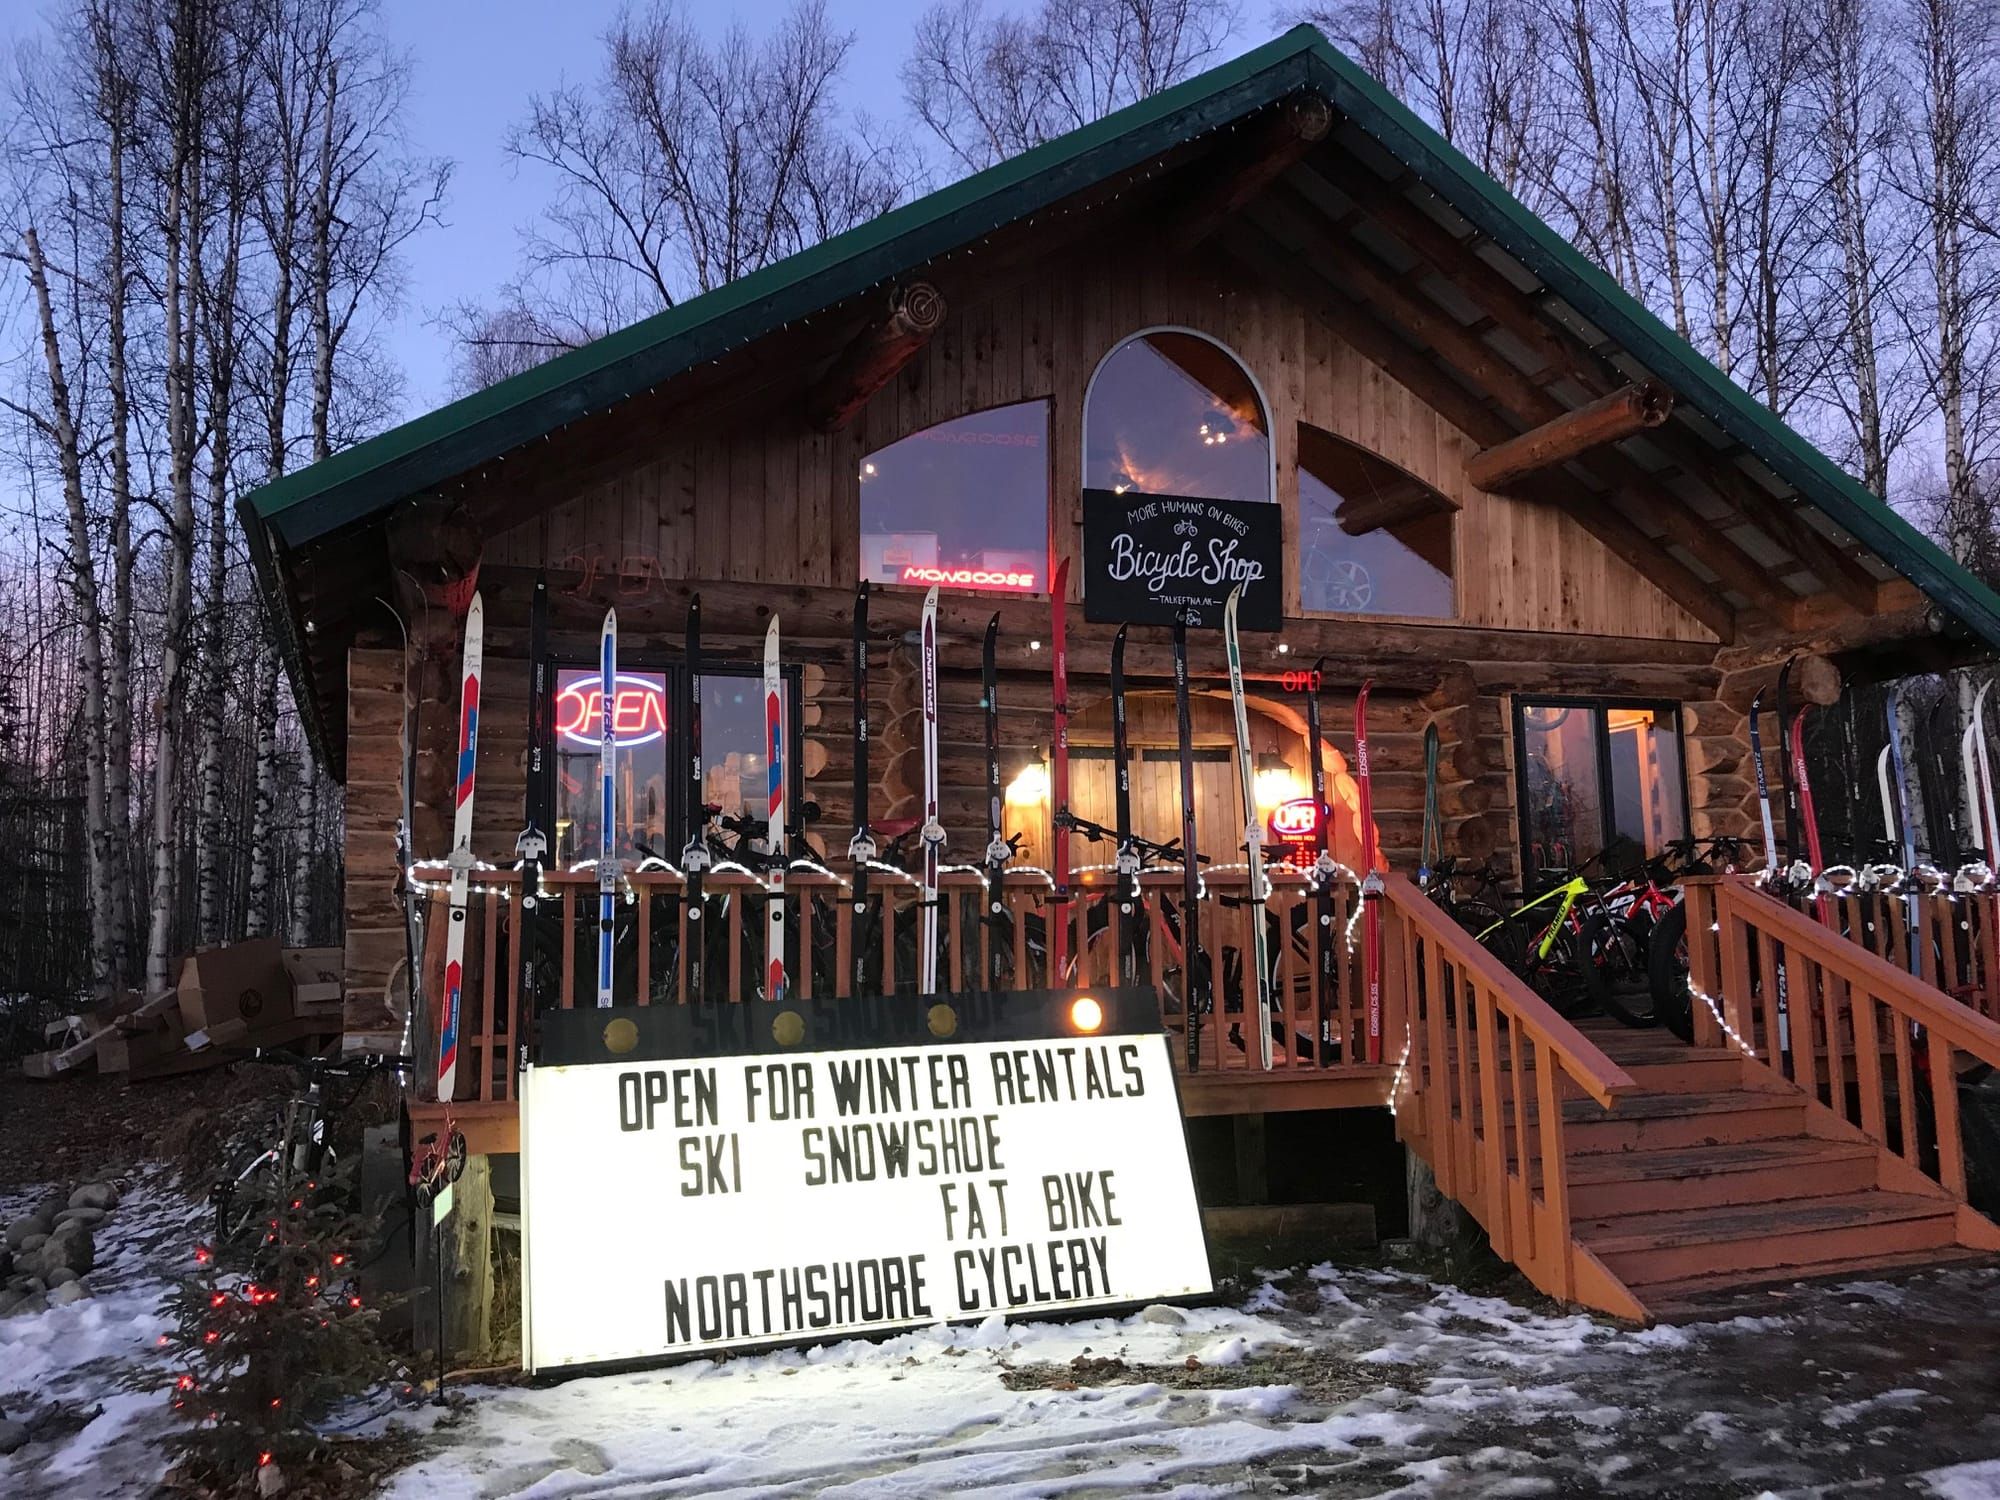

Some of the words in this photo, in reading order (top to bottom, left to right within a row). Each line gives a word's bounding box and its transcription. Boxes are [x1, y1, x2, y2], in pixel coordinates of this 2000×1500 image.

[1127, 503, 1159, 525] MORE
[1162, 501, 1205, 516] HUMANS
[1208, 506, 1224, 522] ON
[1223, 513, 1250, 537] BIKES
[904, 567, 1034, 587] MONGOOSE
[1108, 533, 1202, 592] Bicycle
[1201, 538, 1265, 597] Shop
[926, 646, 935, 715] SPALDING
[604, 697, 614, 745] trak
[1358, 739, 1369, 777] EDSBYN
[1797, 758, 1809, 792] EDSBYN
[520, 1044, 528, 1073] trak
[618, 1067, 718, 1132] OPEN
[744, 1062, 815, 1123] FOR
[828, 1054, 972, 1117] WINTER
[990, 1044, 1145, 1106] RENTALS
[678, 1133, 742, 1197] SKI
[802, 1114, 1005, 1186] SNOWSHOE
[939, 1179, 1009, 1242] FAT
[1042, 1170, 1122, 1232] BIKE
[664, 1253, 933, 1344] NORTHSHORE
[953, 1236, 1112, 1311] CYCLERY
